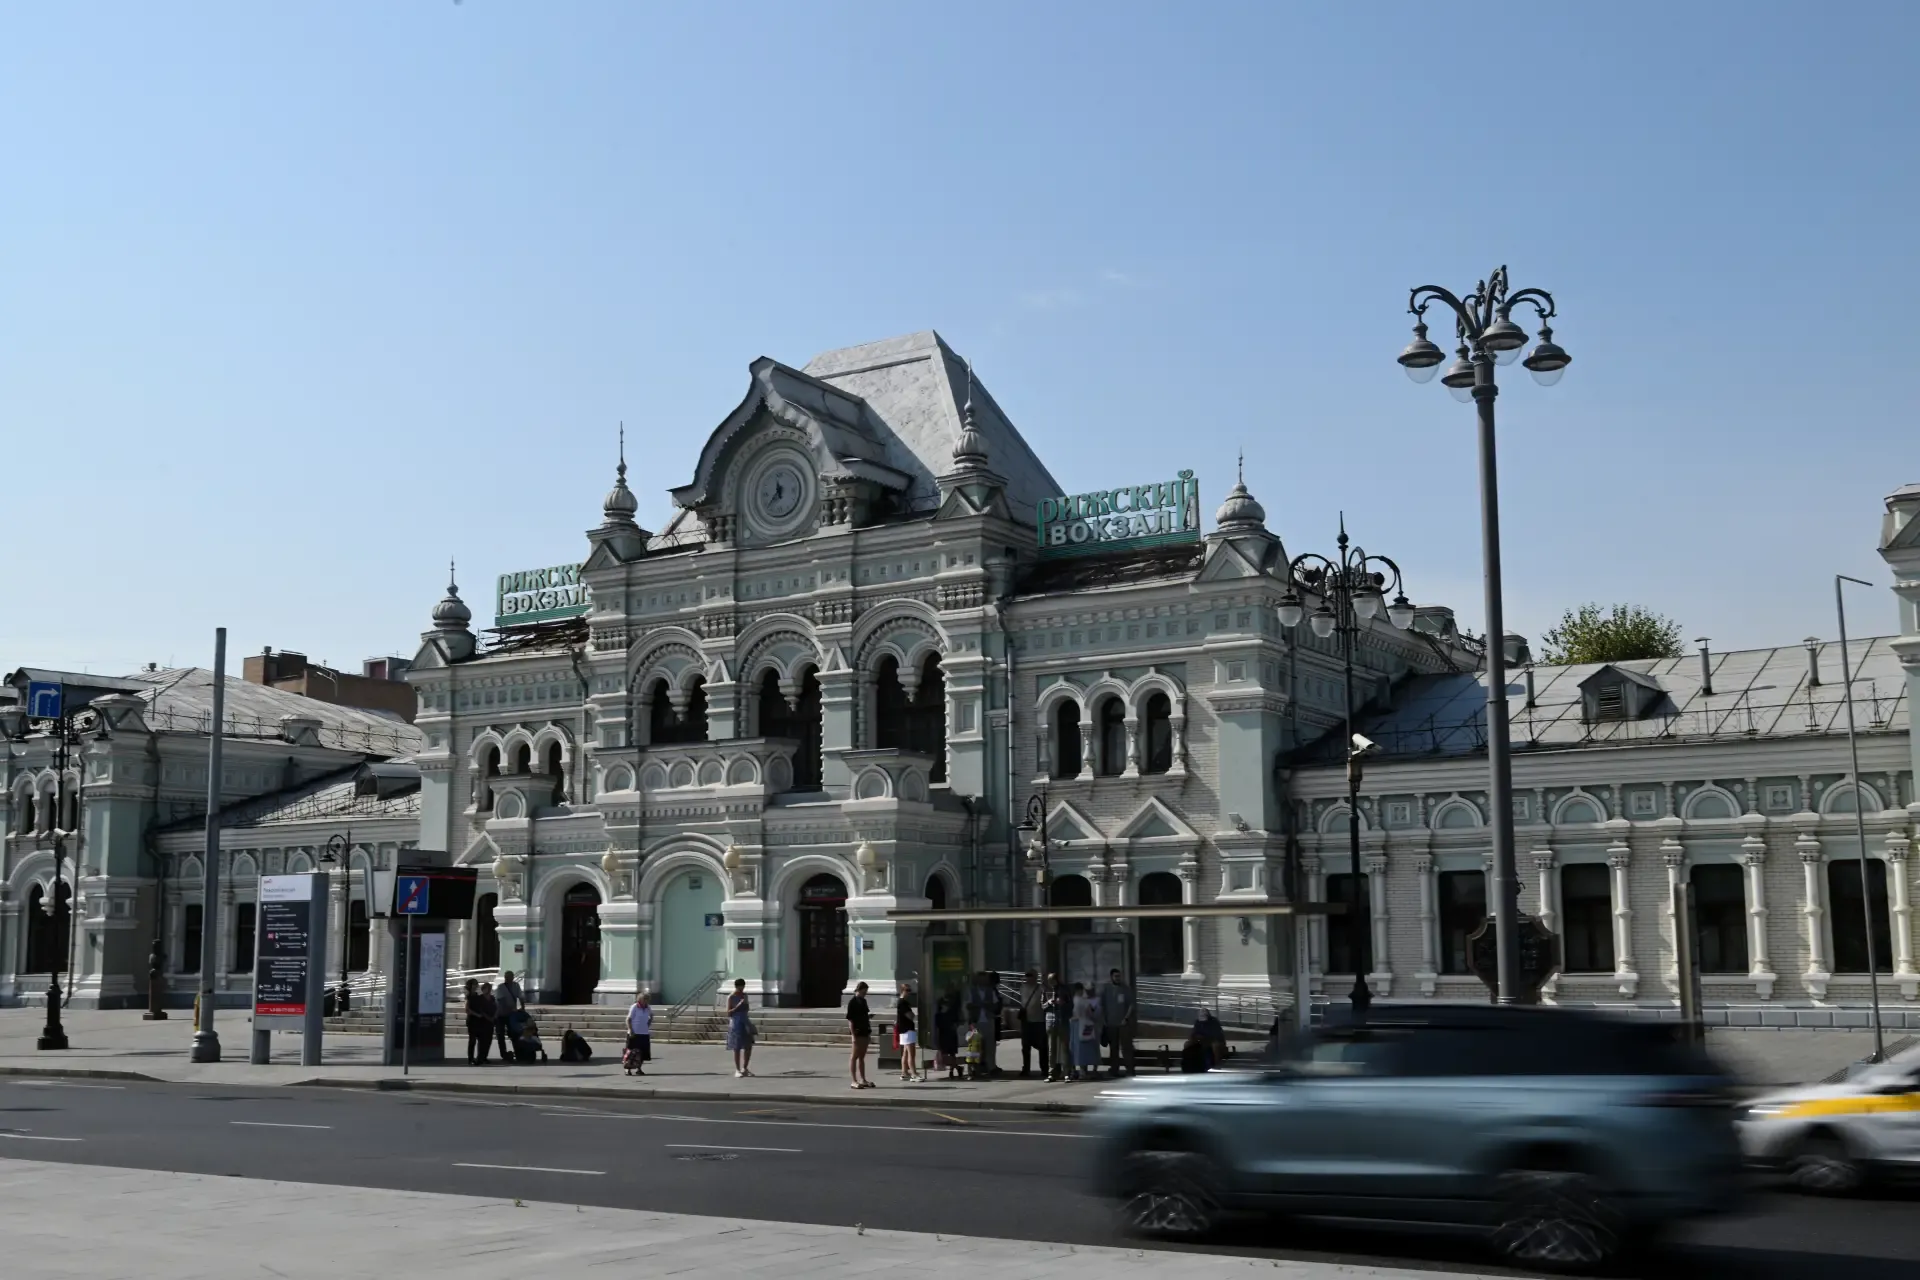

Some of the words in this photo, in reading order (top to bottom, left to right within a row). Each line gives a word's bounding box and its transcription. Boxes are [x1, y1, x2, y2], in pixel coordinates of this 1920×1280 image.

[1038, 469, 1198, 547] РИЖСКИЙ
[1051, 510, 1171, 545] ВОКЗАЛ
[504, 587, 586, 614] ВОКЗАЛ
